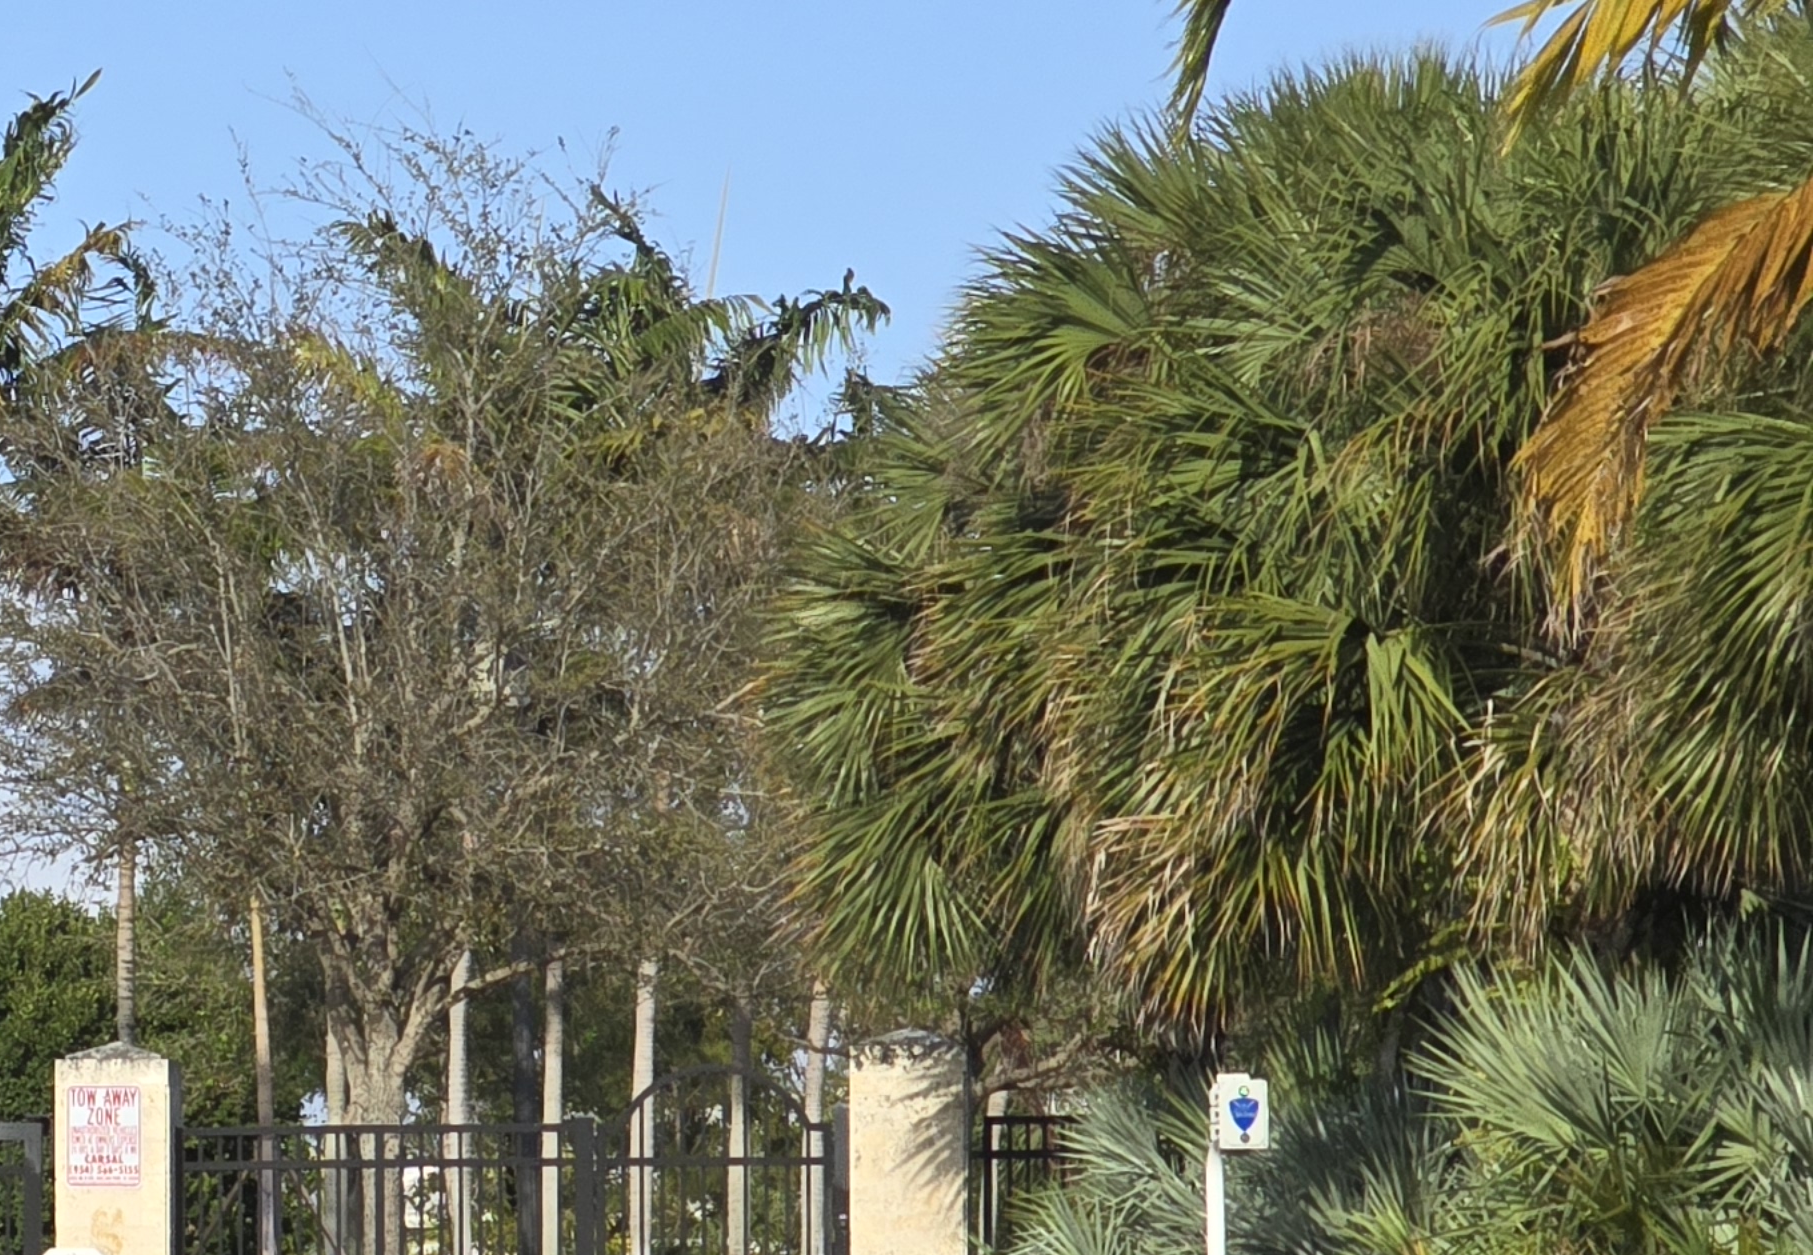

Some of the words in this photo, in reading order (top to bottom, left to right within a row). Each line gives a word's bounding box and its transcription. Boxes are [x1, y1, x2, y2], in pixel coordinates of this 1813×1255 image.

[71, 1088, 97, 1107] TOW
[103, 1088, 137, 1107] AWAY
[87, 1107, 121, 1126] ZONE
